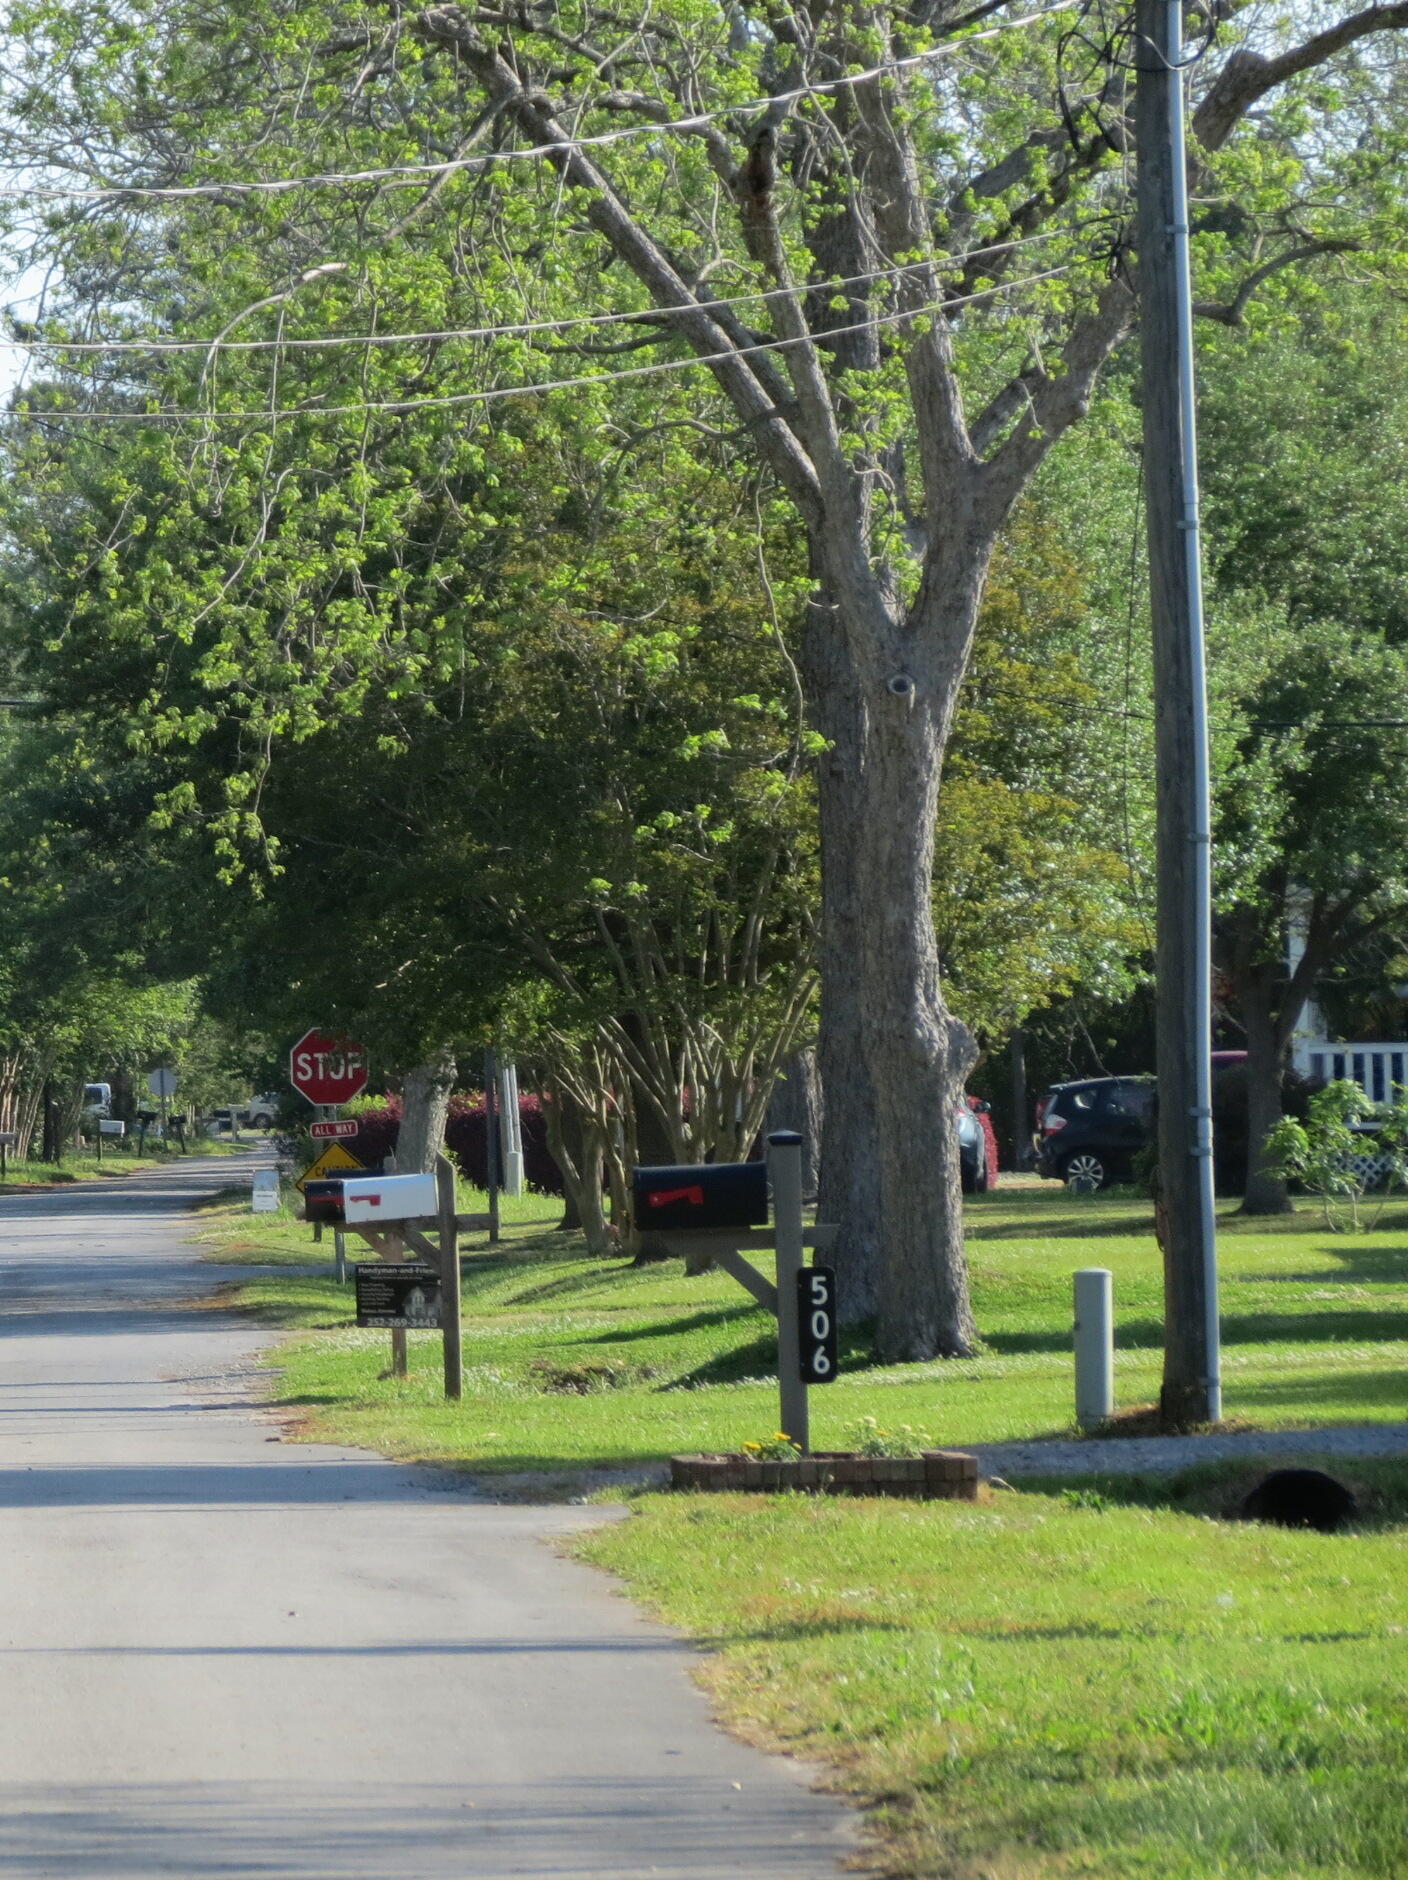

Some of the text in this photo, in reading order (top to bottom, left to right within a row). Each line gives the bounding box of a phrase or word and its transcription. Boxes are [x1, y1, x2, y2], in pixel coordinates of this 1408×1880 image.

[296, 1052, 361, 1080] STOP
[315, 1123, 353, 1136] ALL WAY
[811, 1275, 831, 1375] 506
